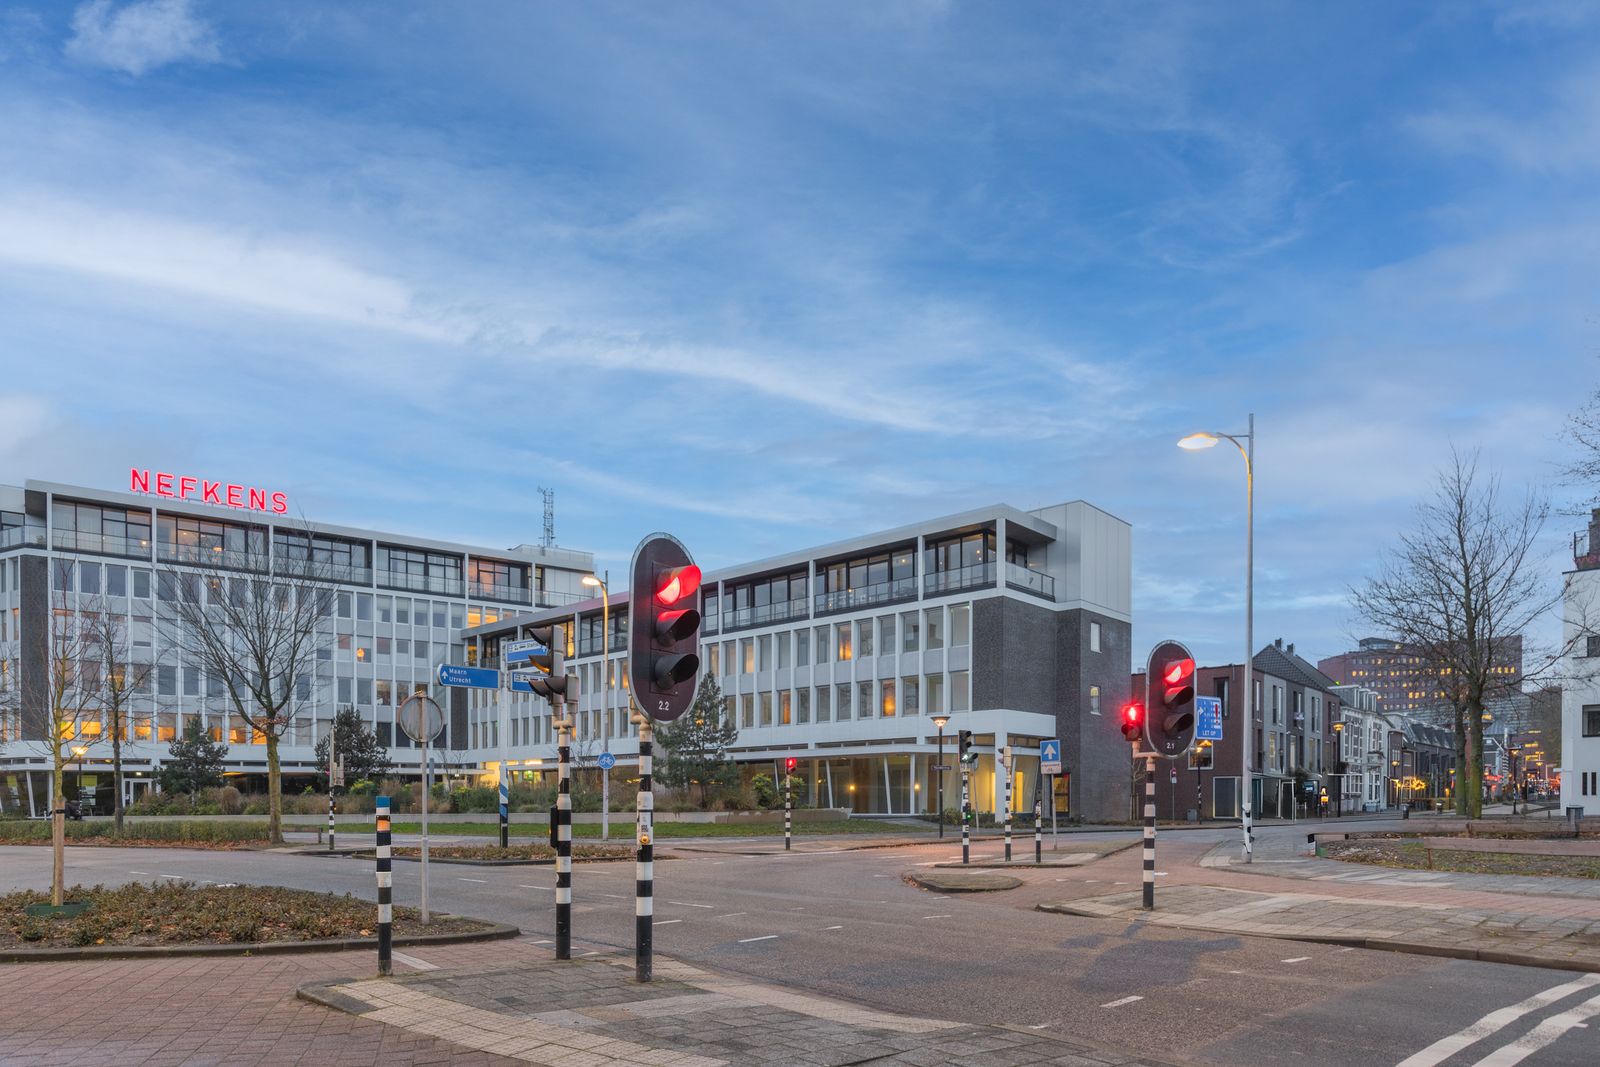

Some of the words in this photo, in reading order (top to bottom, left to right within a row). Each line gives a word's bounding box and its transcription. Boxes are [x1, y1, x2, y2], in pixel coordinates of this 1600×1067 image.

[130, 468, 288, 514] NEFKENS
[448, 667, 468, 675] Maarn
[448, 676, 472, 684] Utrecht
